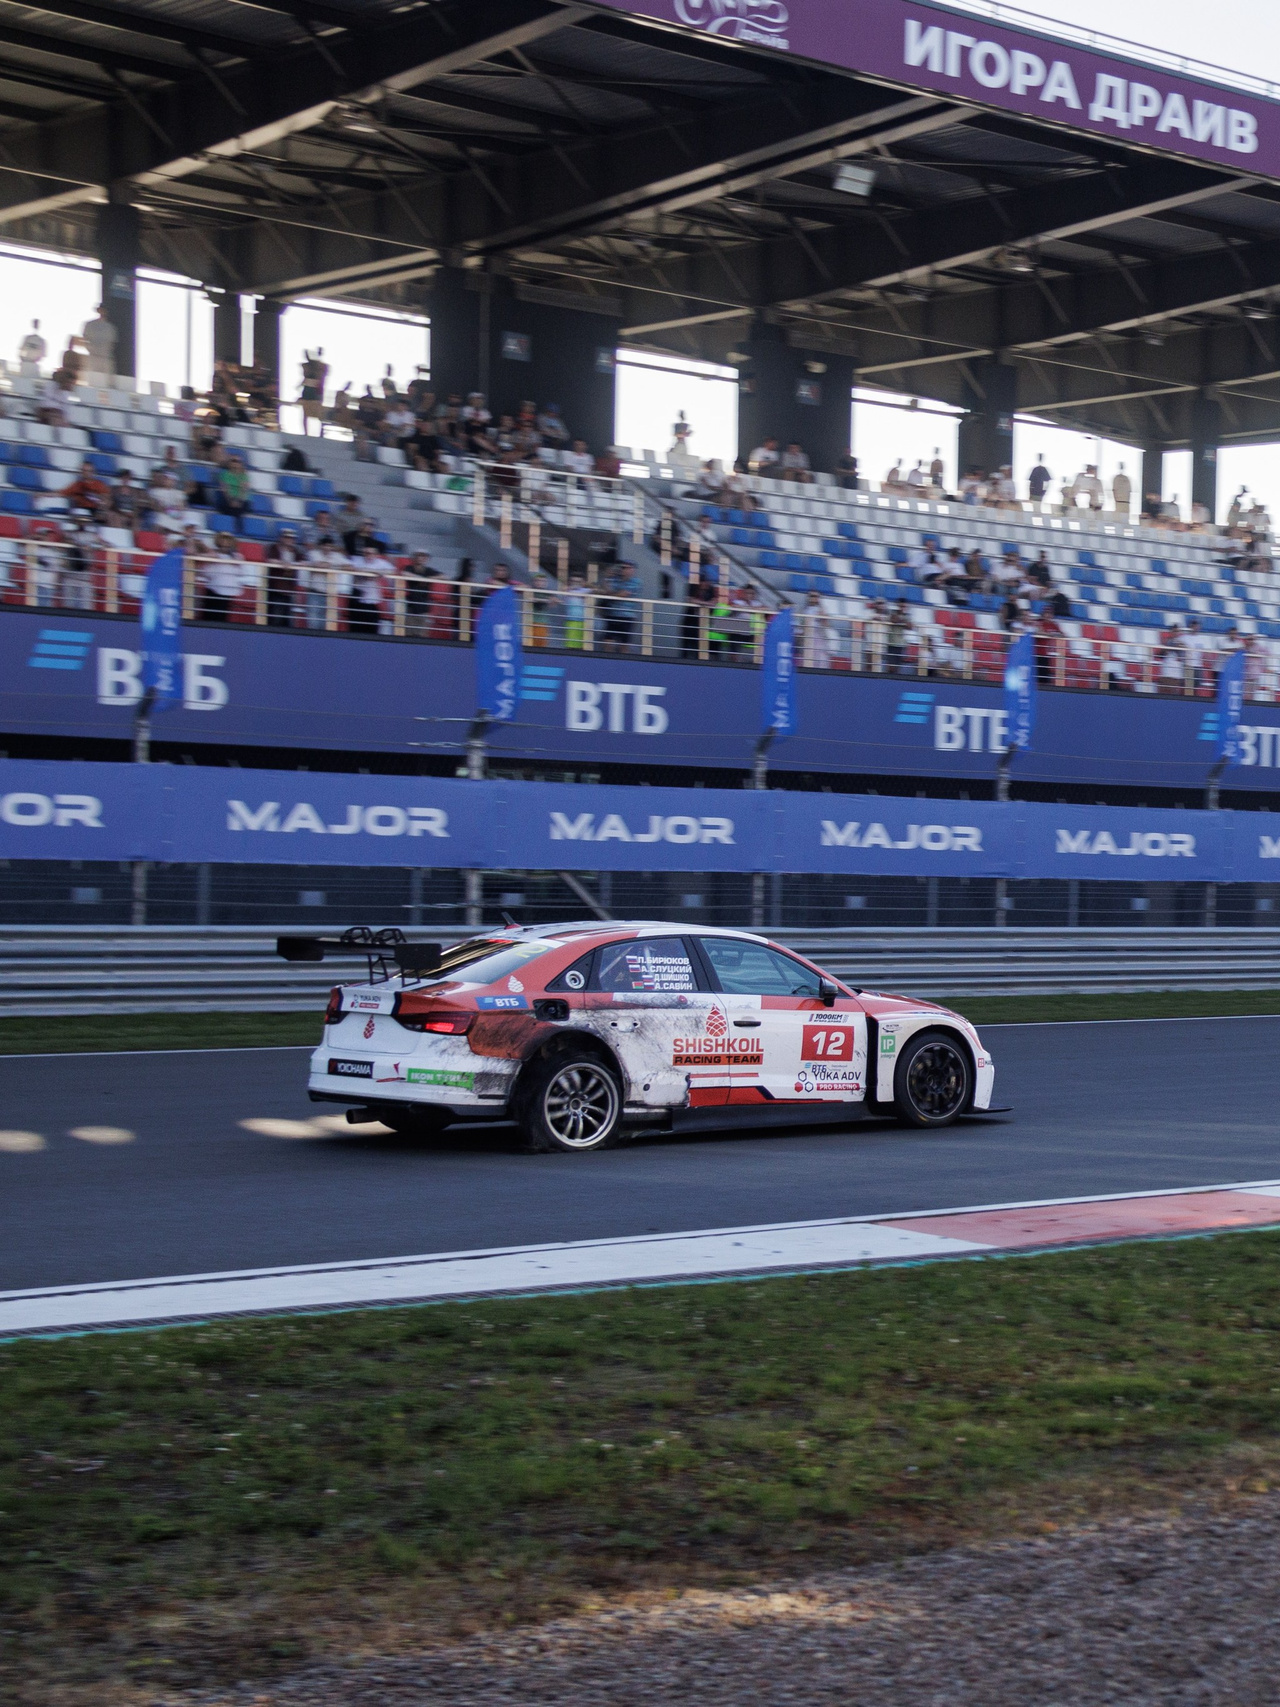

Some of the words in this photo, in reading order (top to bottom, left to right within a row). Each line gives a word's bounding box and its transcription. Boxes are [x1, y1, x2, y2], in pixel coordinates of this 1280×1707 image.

[903, 19, 1083, 110] ИГОРА
[97, 648, 229, 711] ВБ
[566, 681, 668, 734] ВТБ
[227, 800, 450, 837] MAJOR
[550, 812, 735, 844] MAJOR
[821, 821, 983, 851] MAJOR
[1056, 830, 1196, 857] MAJOR
[637, 956, 690, 965] П.БИРЮКОВ
[641, 965, 693, 975] А.СЛУЦКИЙ
[654, 974, 690, 982] Д.ШИШКО
[655, 982, 693, 990] А.САВИН
[495, 998, 519, 1007] ВТБ
[673, 1038, 764, 1053] SHISHKOIL
[812, 1031, 846, 1056] 12
[883, 1039, 894, 1050] IP
[674, 1056, 722, 1064] RACING
[726, 1055, 760, 1063] TEAM
[337, 1062, 372, 1075] YOKOHAMA
[811, 1064, 827, 1073] ВТБ
[411, 1072, 434, 1081] IKON
[841, 1071, 861, 1081] ADV
